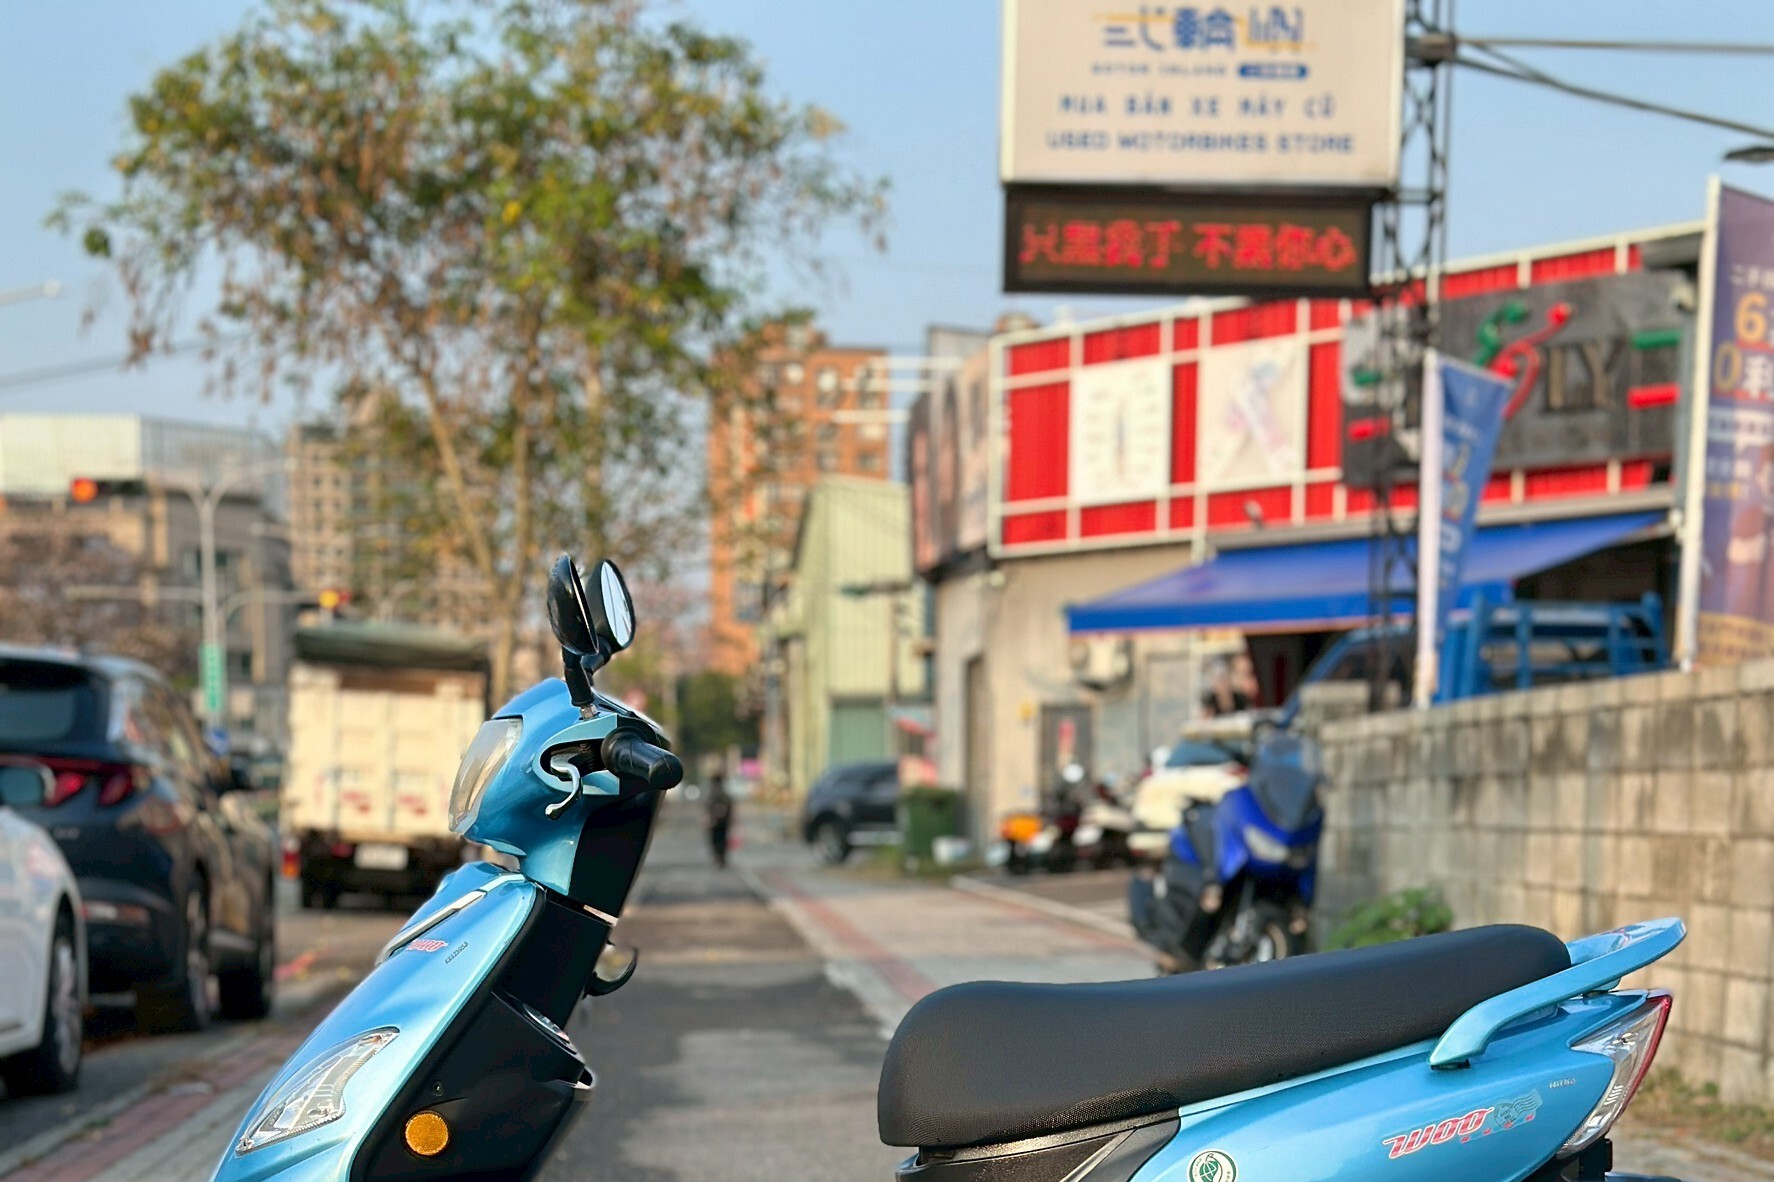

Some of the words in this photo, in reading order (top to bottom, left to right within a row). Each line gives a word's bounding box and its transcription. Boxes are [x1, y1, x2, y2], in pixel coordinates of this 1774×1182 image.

[1060, 95, 1107, 115] MUA
[1191, 97, 1220, 117] XE
[1046, 131, 1110, 150] USED
[1118, 132, 1268, 152] MOTORBIKES
[1277, 133, 1355, 153] STORE
